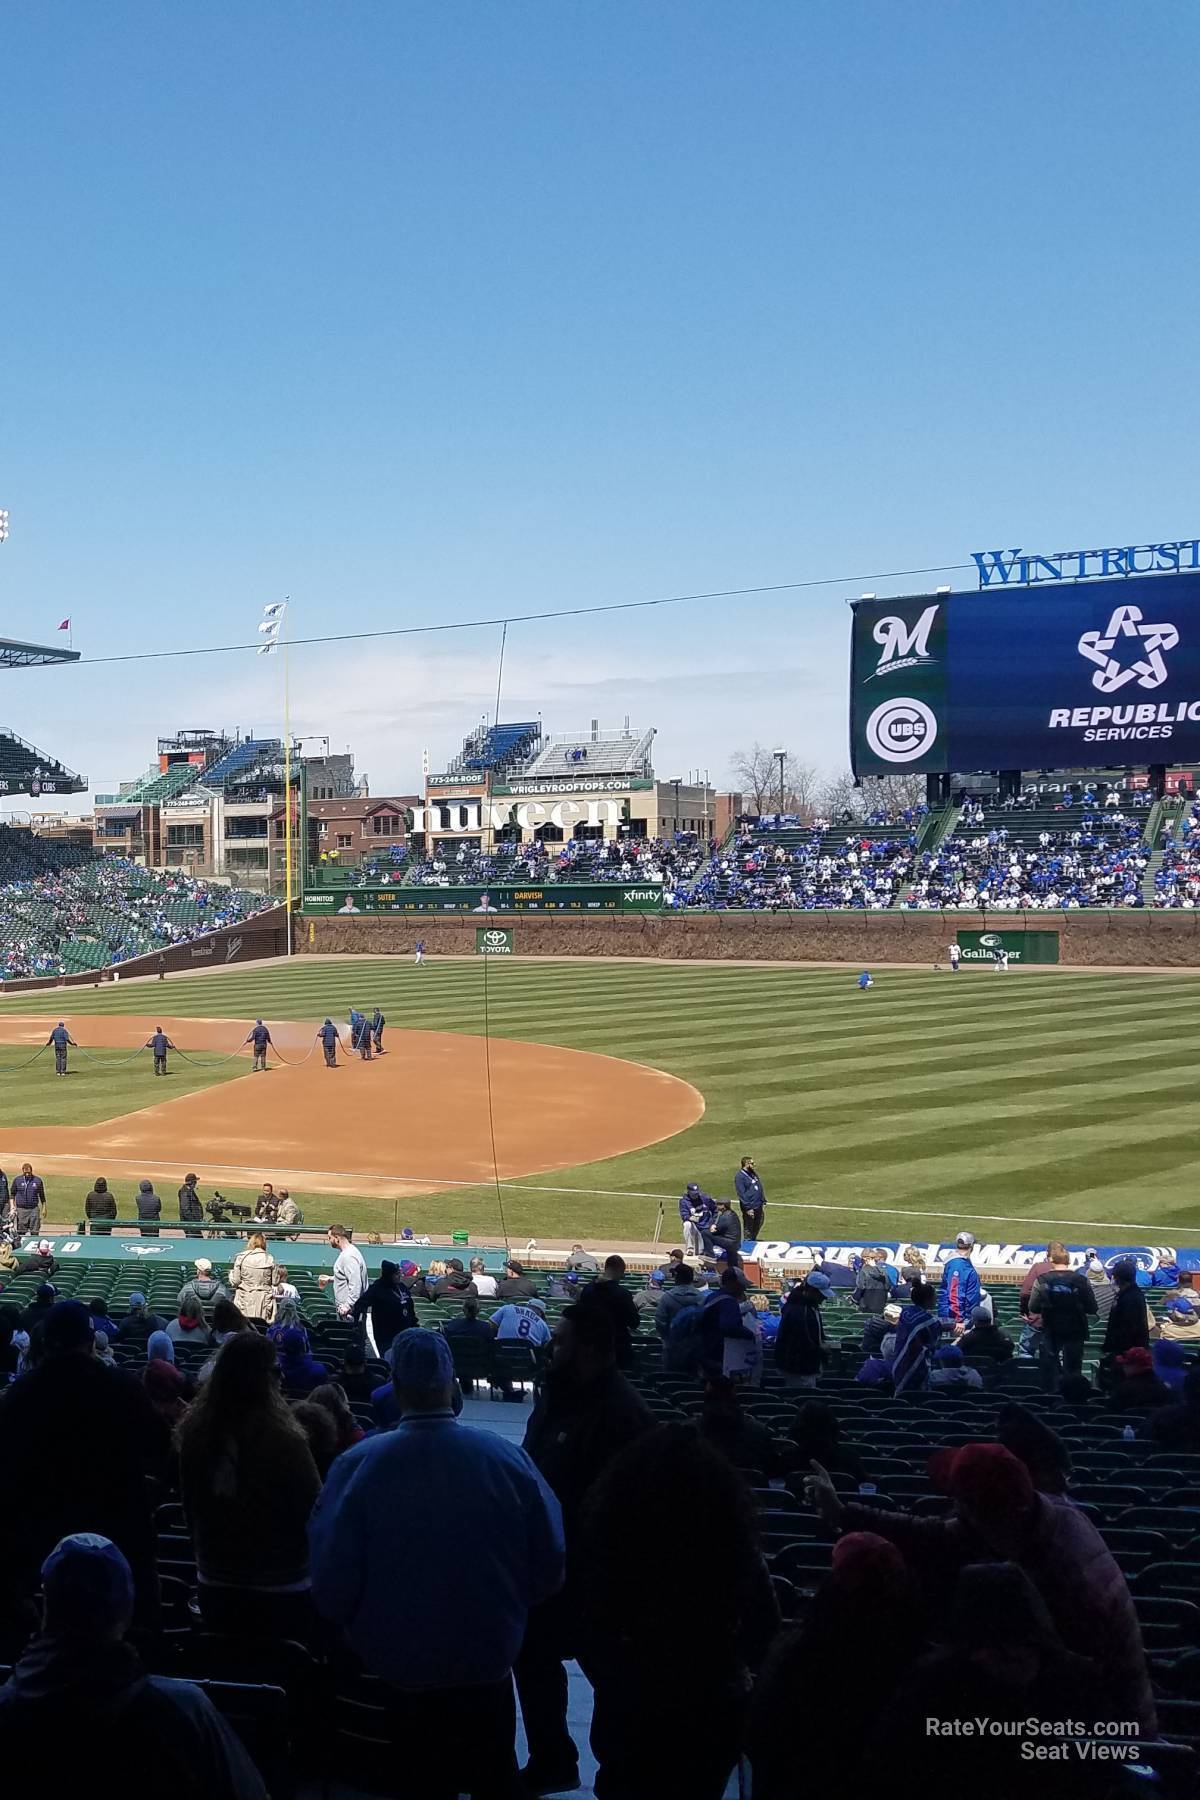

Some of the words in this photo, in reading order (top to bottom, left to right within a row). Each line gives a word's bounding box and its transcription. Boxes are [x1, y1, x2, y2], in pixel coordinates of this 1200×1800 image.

[1083, 725, 1173, 742] SERVICES
[42, 782, 56, 791] CUBS
[509, 782, 631, 794] WRIGLEYROOFTOPS.COM
[409, 798, 623, 833] nuveen
[623, 890, 661, 902] xfinity
[518, 1319, 530, 1337] 8
